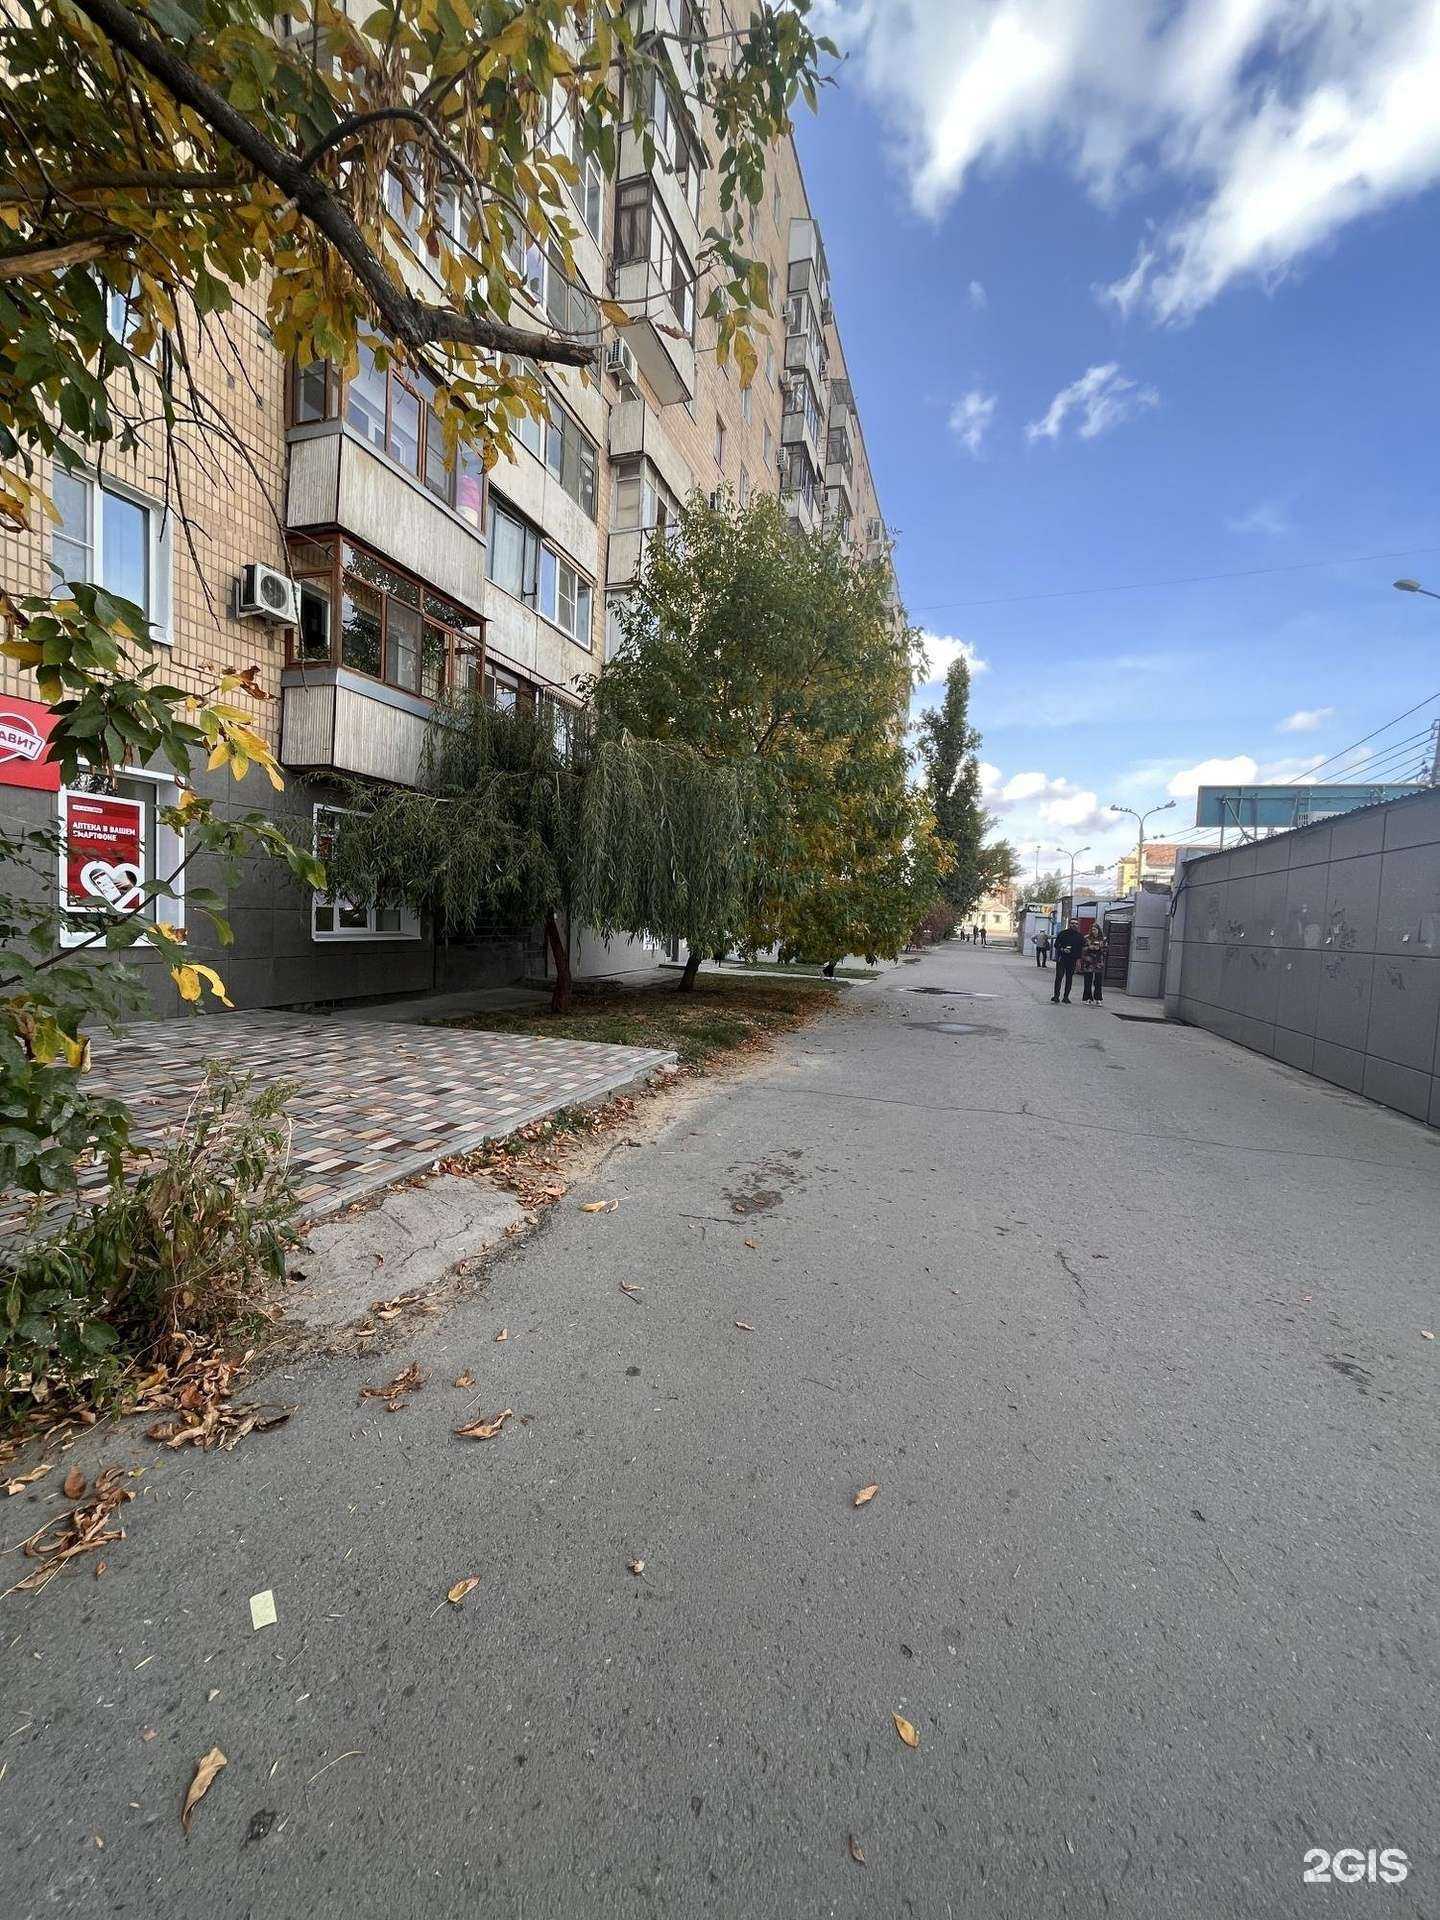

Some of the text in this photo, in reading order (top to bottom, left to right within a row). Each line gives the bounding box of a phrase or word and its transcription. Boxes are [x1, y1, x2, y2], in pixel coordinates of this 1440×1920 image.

[73, 822, 101, 832] АПТЕКА
[109, 826, 136, 835] ВАШЕМ
[73, 830, 118, 841] СМАРТФОНЕ
